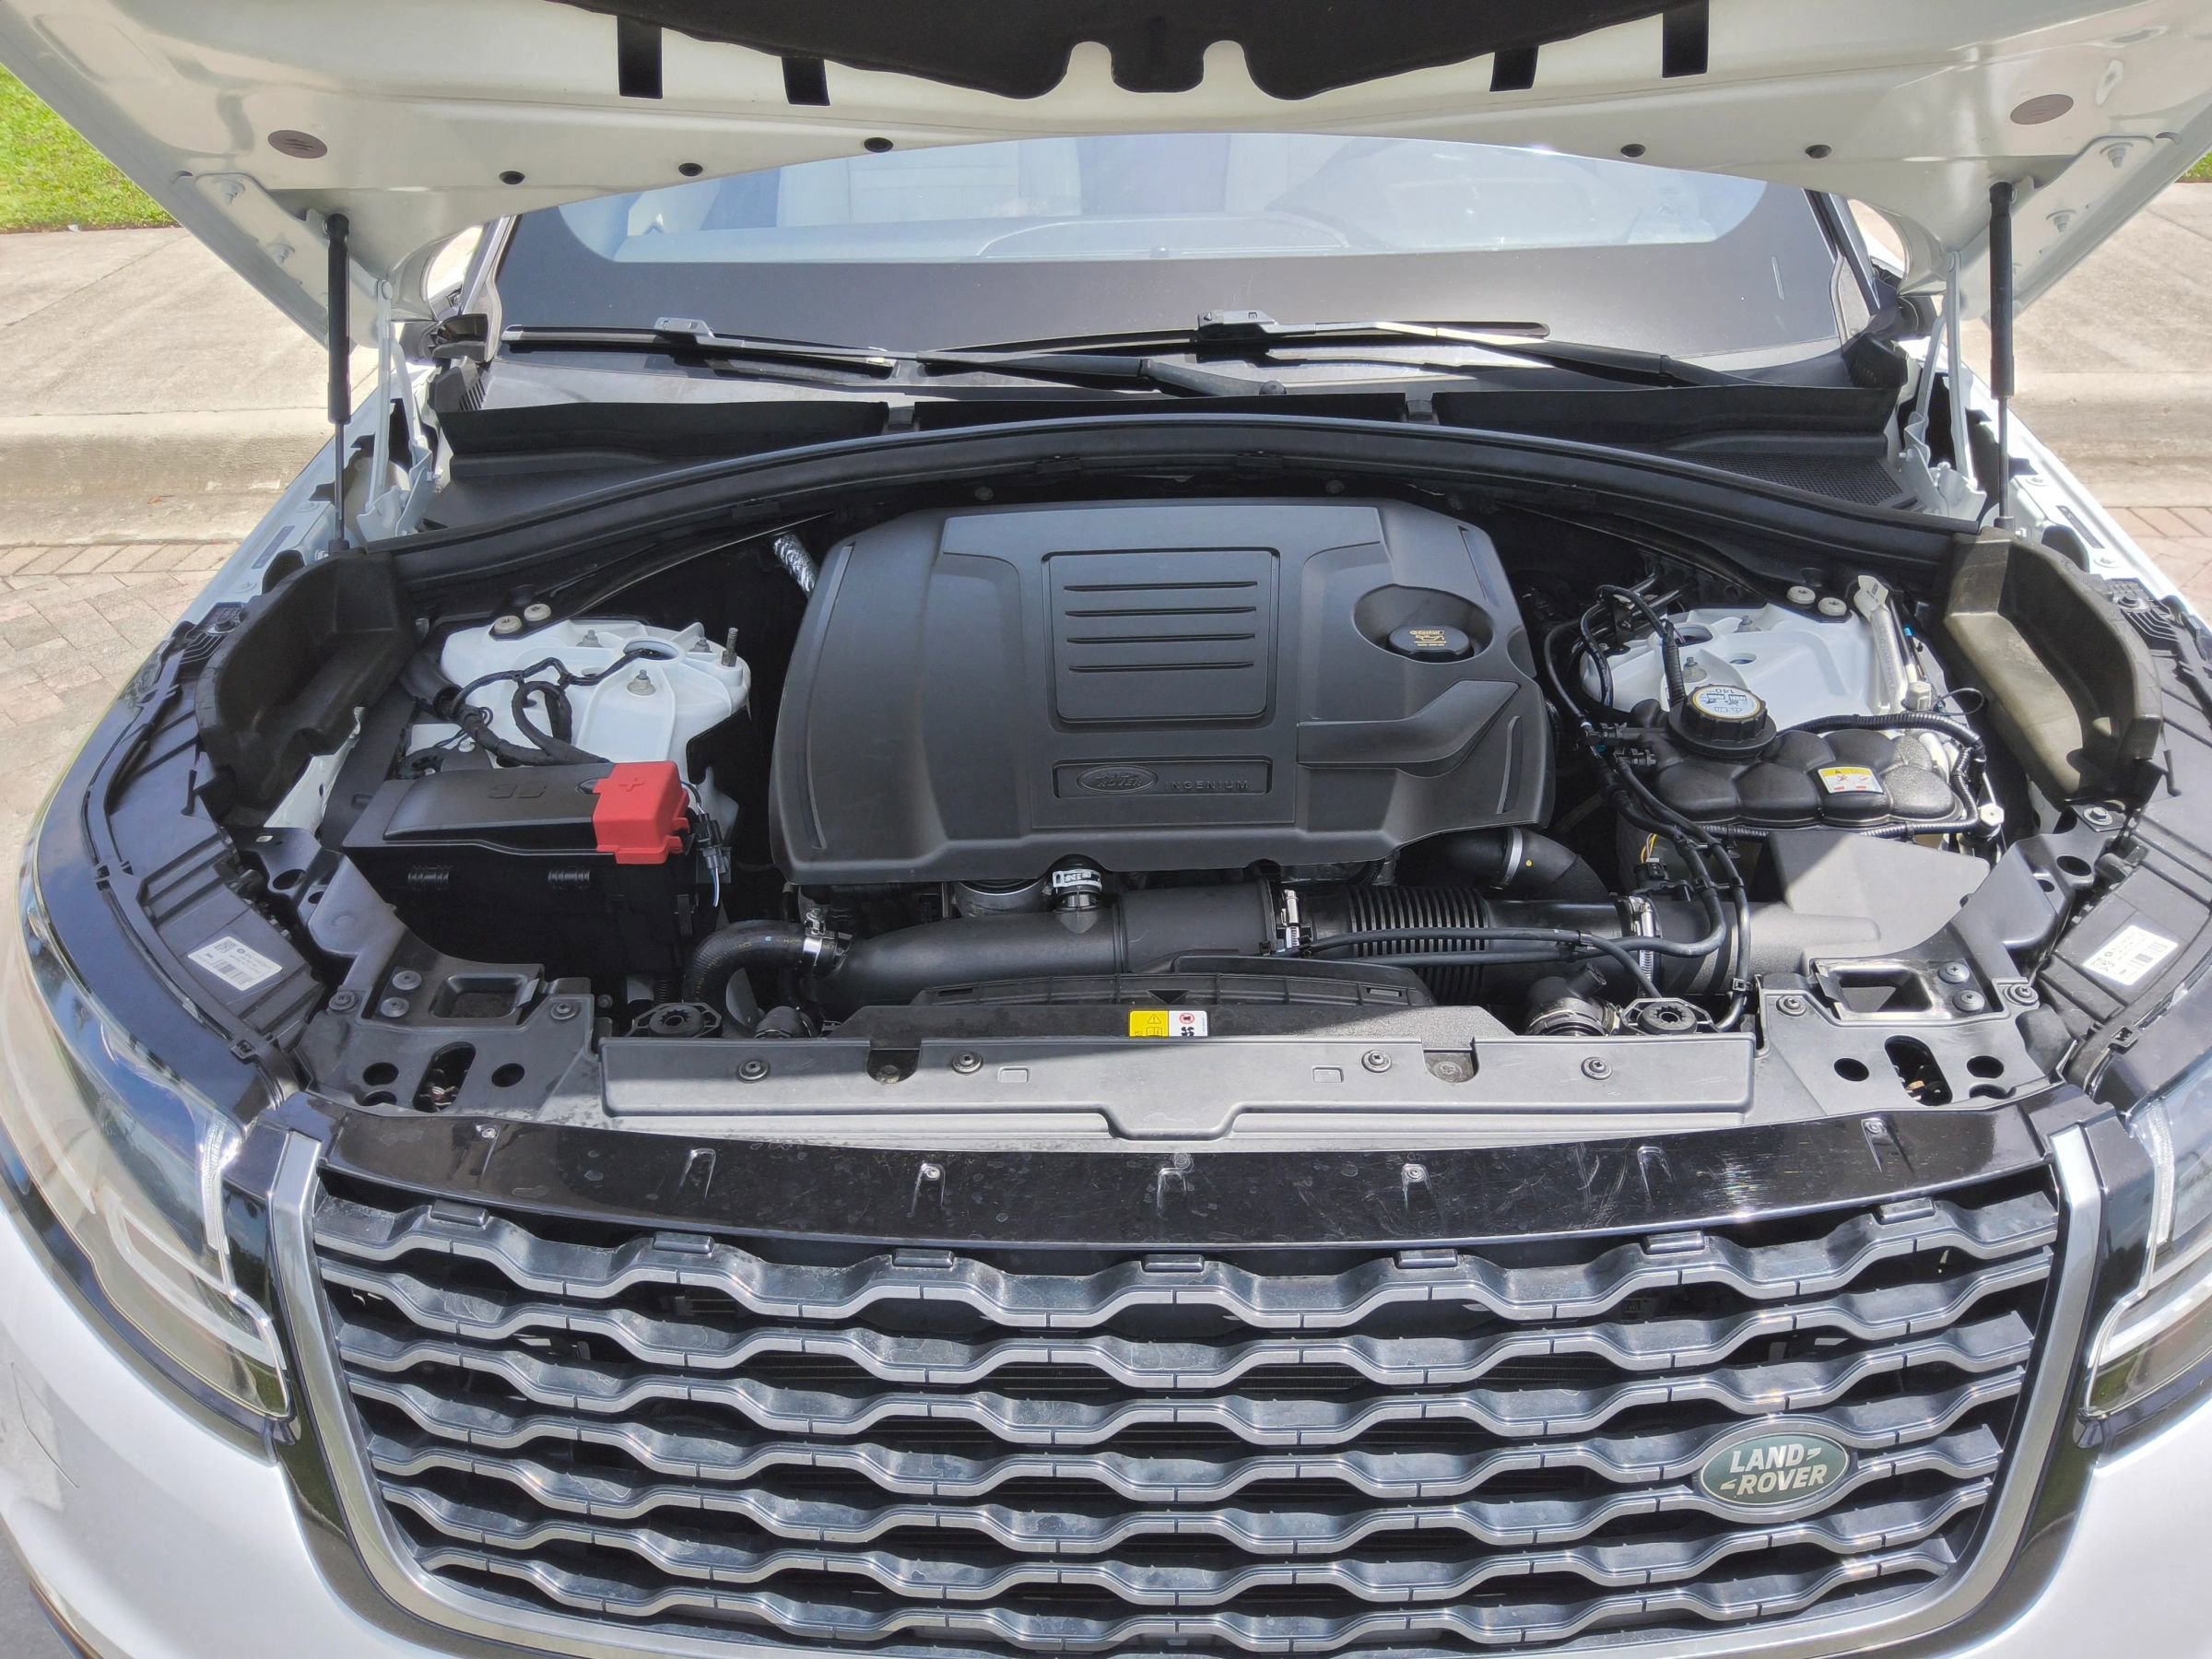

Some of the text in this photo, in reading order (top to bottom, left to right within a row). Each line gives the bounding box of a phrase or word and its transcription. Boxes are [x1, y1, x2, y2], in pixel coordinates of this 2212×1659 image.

[1164, 780, 1250, 791] INGENIUM
[1729, 1443, 1805, 1474] LAND
[1736, 1464, 1828, 1496] ROVER
